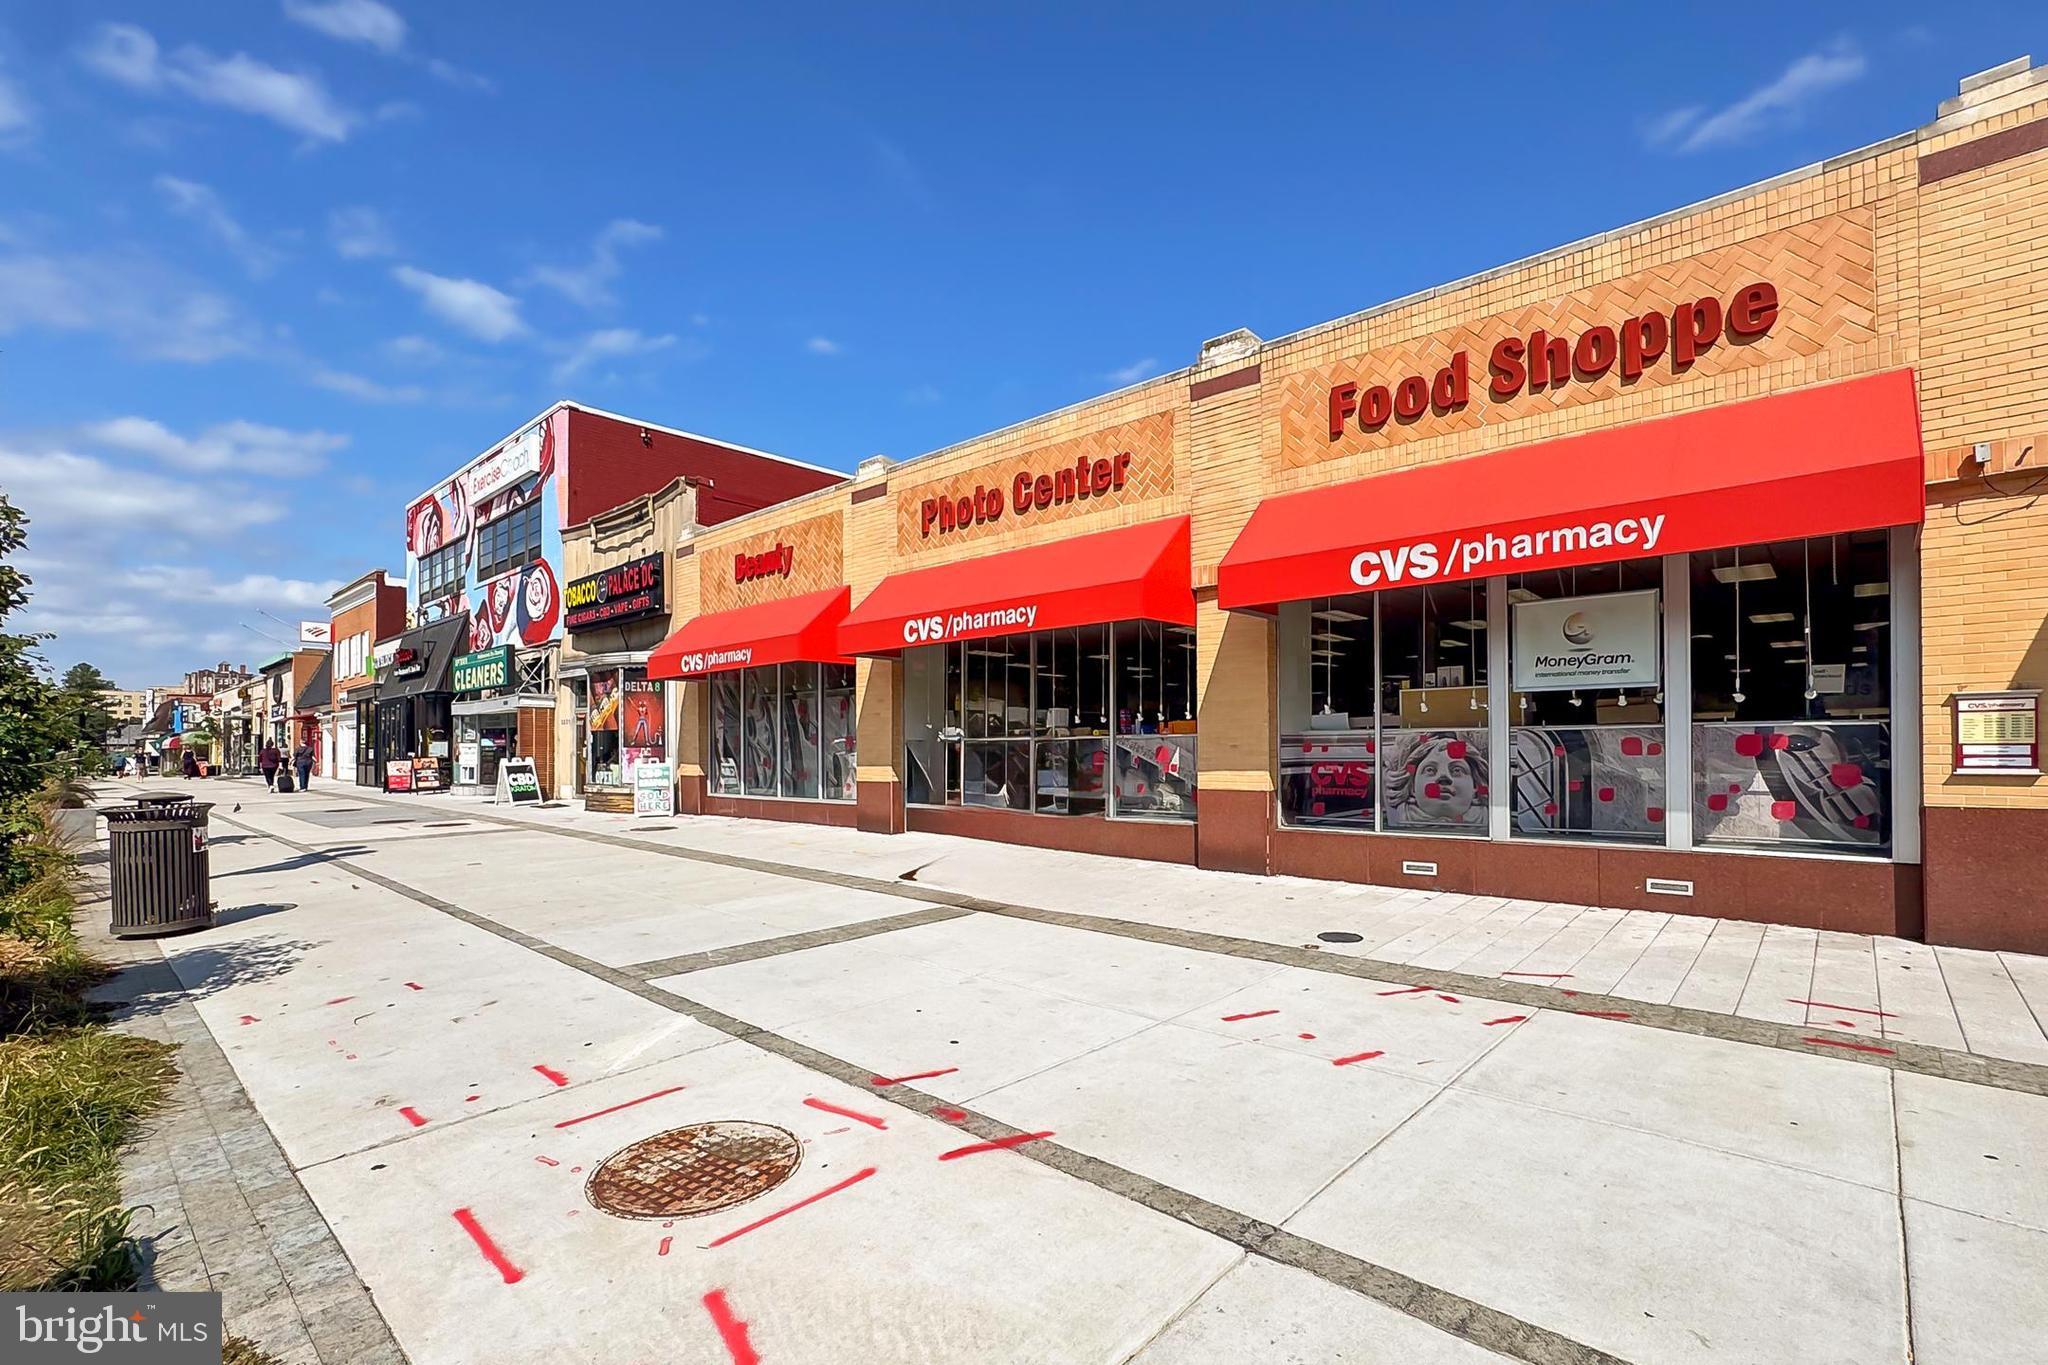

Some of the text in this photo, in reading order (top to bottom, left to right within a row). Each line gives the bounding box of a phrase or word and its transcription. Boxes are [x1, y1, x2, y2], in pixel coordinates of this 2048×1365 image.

[1329, 281, 1779, 442] Food Shoppe
[921, 451, 1131, 538] Photo Center
[735, 543, 794, 584] Beauty
[564, 562, 654, 608] TOBACCO PALACE DC
[614, 602, 628, 614] VAPE
[632, 596, 650, 609] GIFTS
[455, 661, 504, 691] CLEANERS
[1535, 670, 1577, 678] international
[625, 681, 654, 692] DELTA
[654, 681, 661, 692] 8
[509, 773, 535, 786] CBD
[1311, 761, 1369, 786] CVS
[640, 791, 669, 801] SOLD
[1312, 785, 1368, 799] pharmacy
[640, 801, 669, 810] HERE
